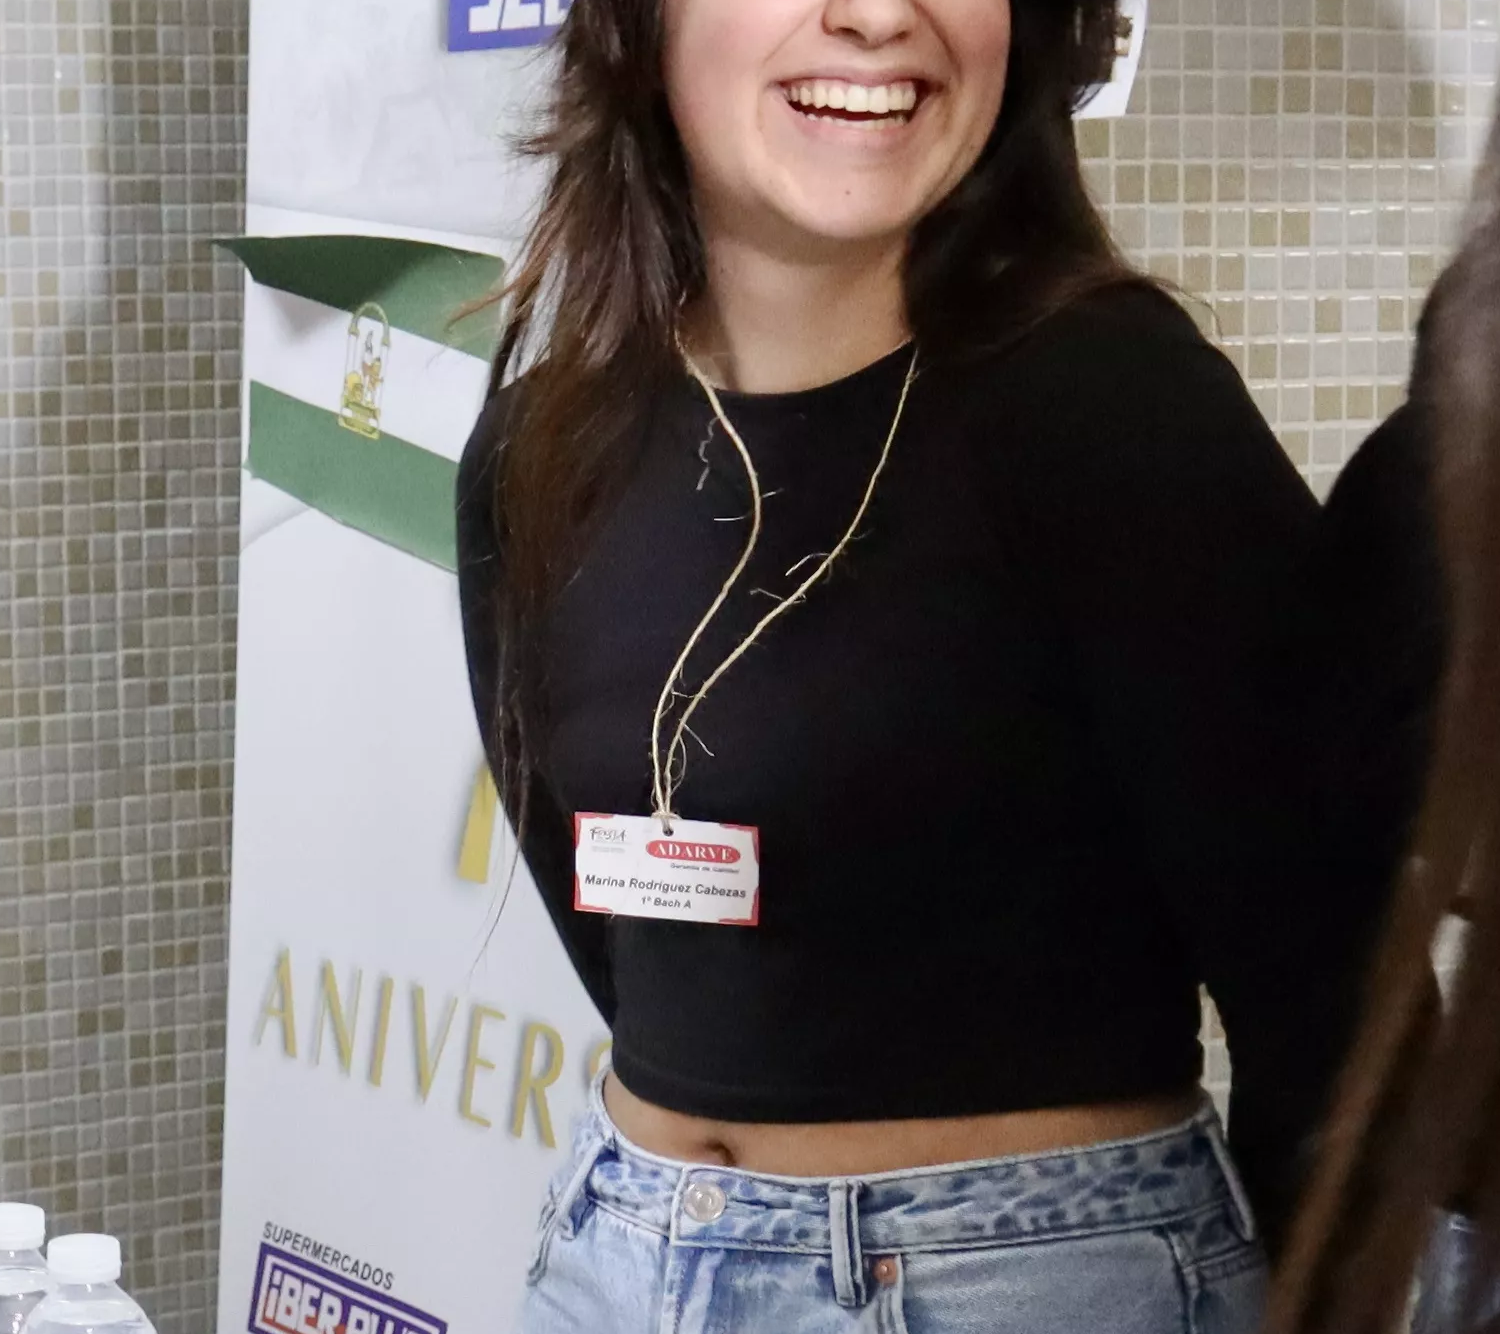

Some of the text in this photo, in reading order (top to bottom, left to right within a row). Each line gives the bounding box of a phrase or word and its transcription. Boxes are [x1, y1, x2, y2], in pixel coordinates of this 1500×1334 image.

[655, 841, 733, 862] ADARVE
[584, 874, 625, 888] Marina
[695, 883, 747, 899] Cabezas
[653, 897, 681, 909] Bach
[683, 900, 692, 909] A
[263, 1221, 395, 1291] SUPERMERCADOS
